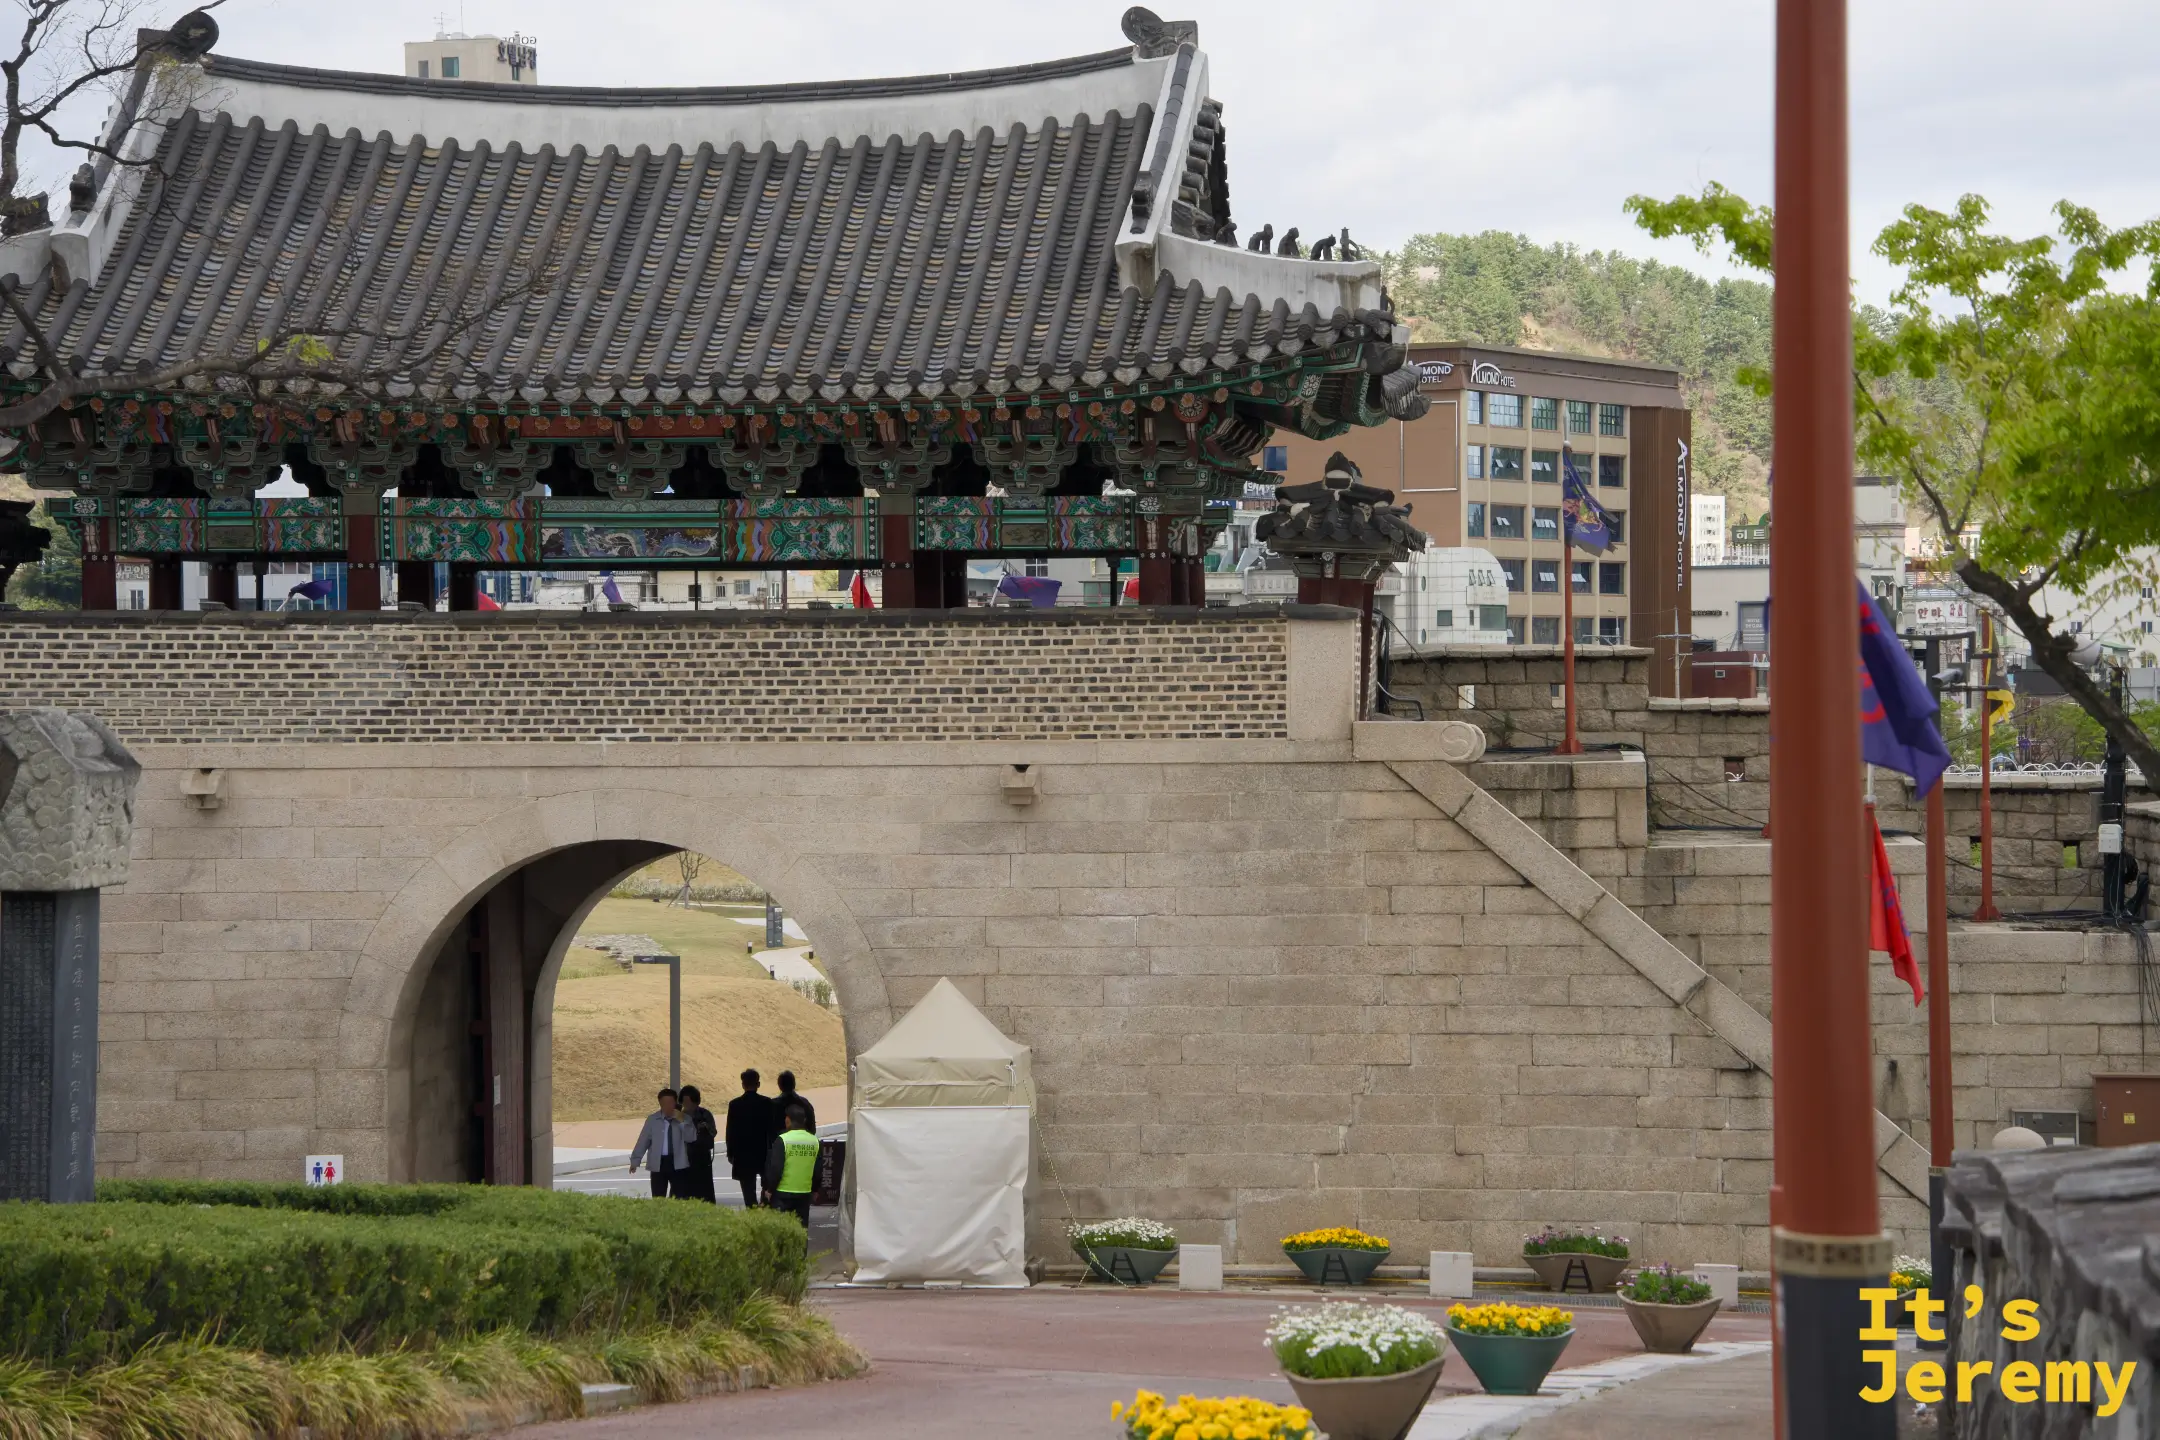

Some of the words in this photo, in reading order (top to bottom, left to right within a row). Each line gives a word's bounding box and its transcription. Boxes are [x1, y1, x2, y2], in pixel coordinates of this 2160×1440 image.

[1420, 376, 1442, 384] OTEL
[1470, 358, 1502, 385] ALMOND
[1500, 375, 1516, 388] HOTEL
[1677, 437, 1688, 541] ALMOND
